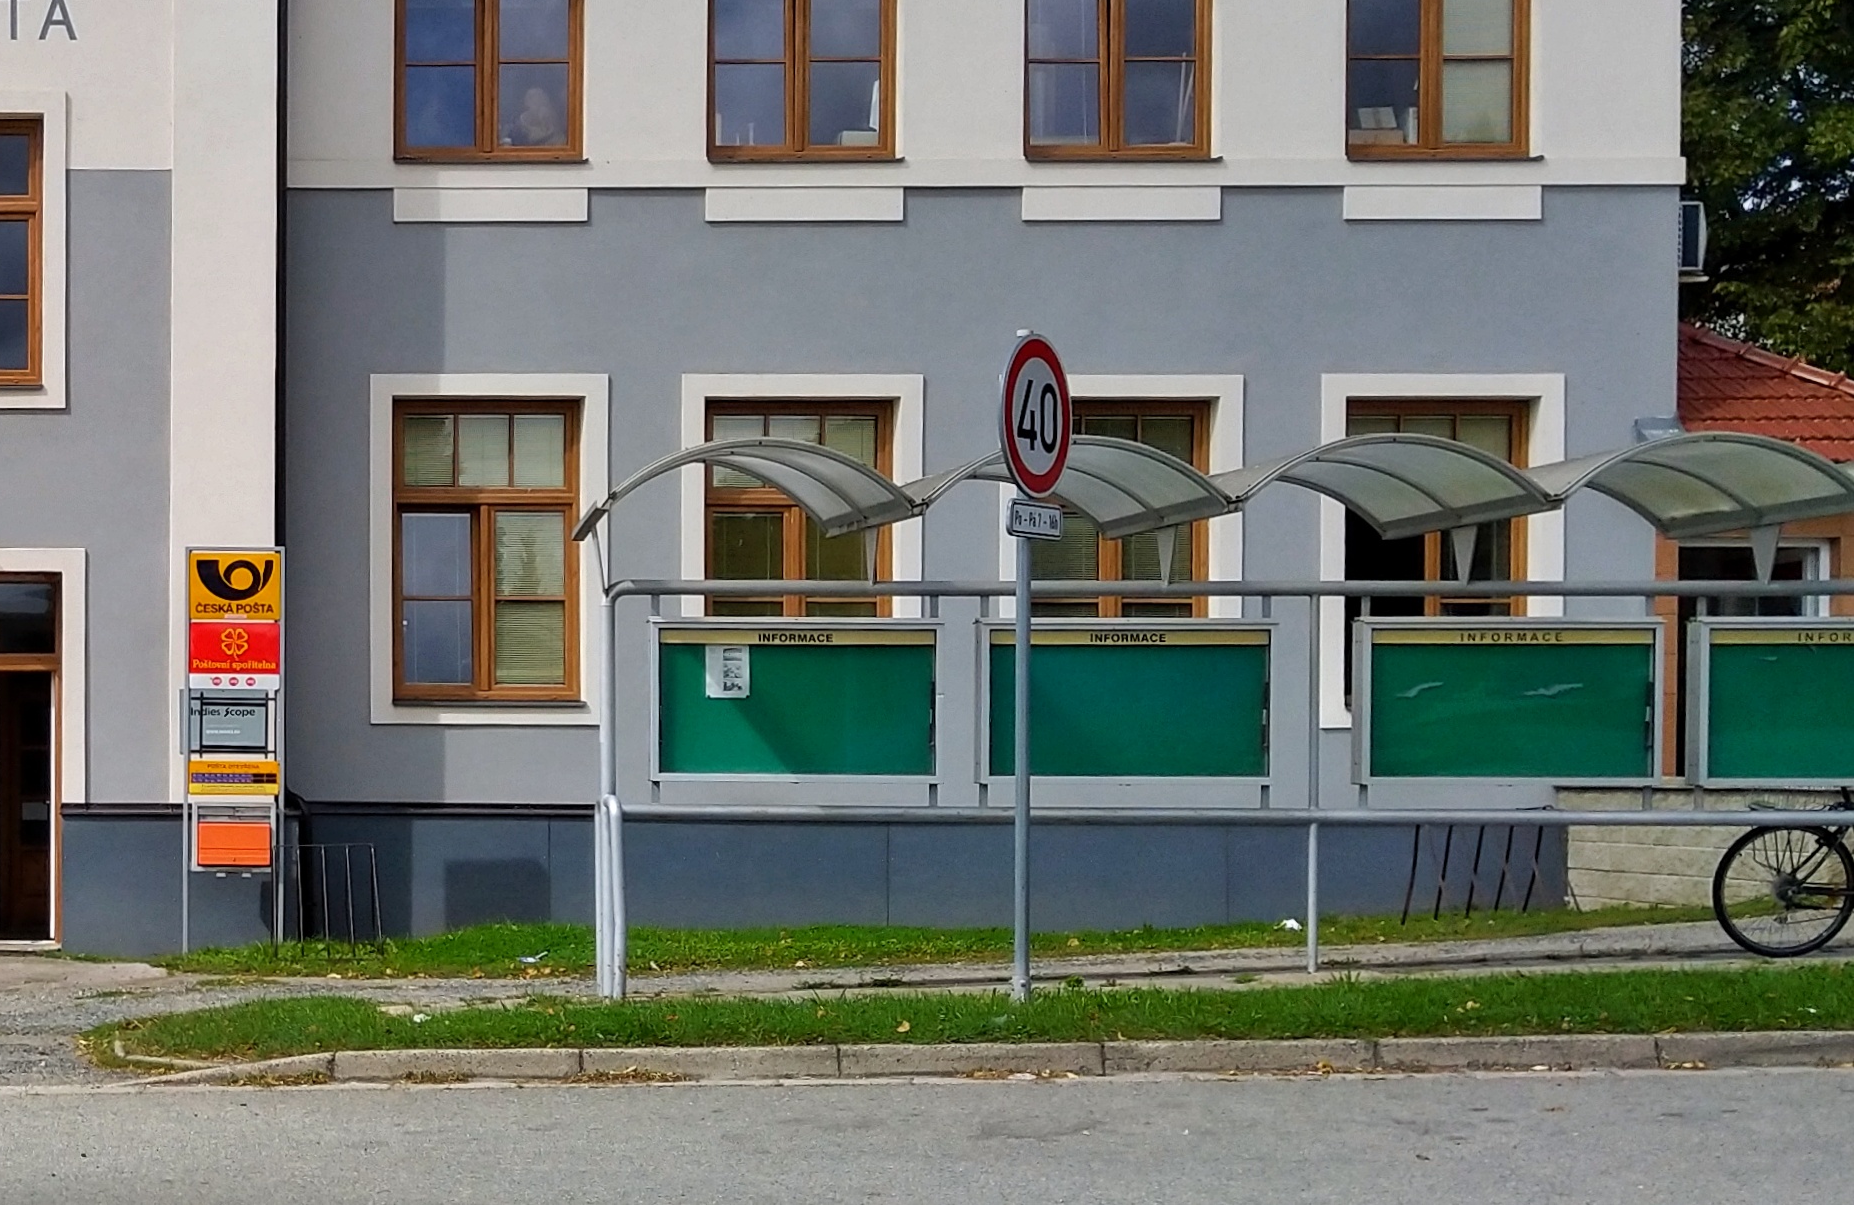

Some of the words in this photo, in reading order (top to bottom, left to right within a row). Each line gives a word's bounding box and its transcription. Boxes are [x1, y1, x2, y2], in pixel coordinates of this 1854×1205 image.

[1017, 379, 1058, 454] 40
[1014, 509, 1022, 526] Po
[195, 602, 234, 614] ČESKÁ
[236, 602, 274, 614] POŠTA
[758, 633, 834, 643] INFORMACE
[1089, 633, 1166, 643] INFORMACE
[1460, 632, 1563, 642] INFORMACE
[192, 659, 231, 669] Poštovní
[232, 660, 276, 671] spořitelna
[224, 707, 256, 717] Scope
